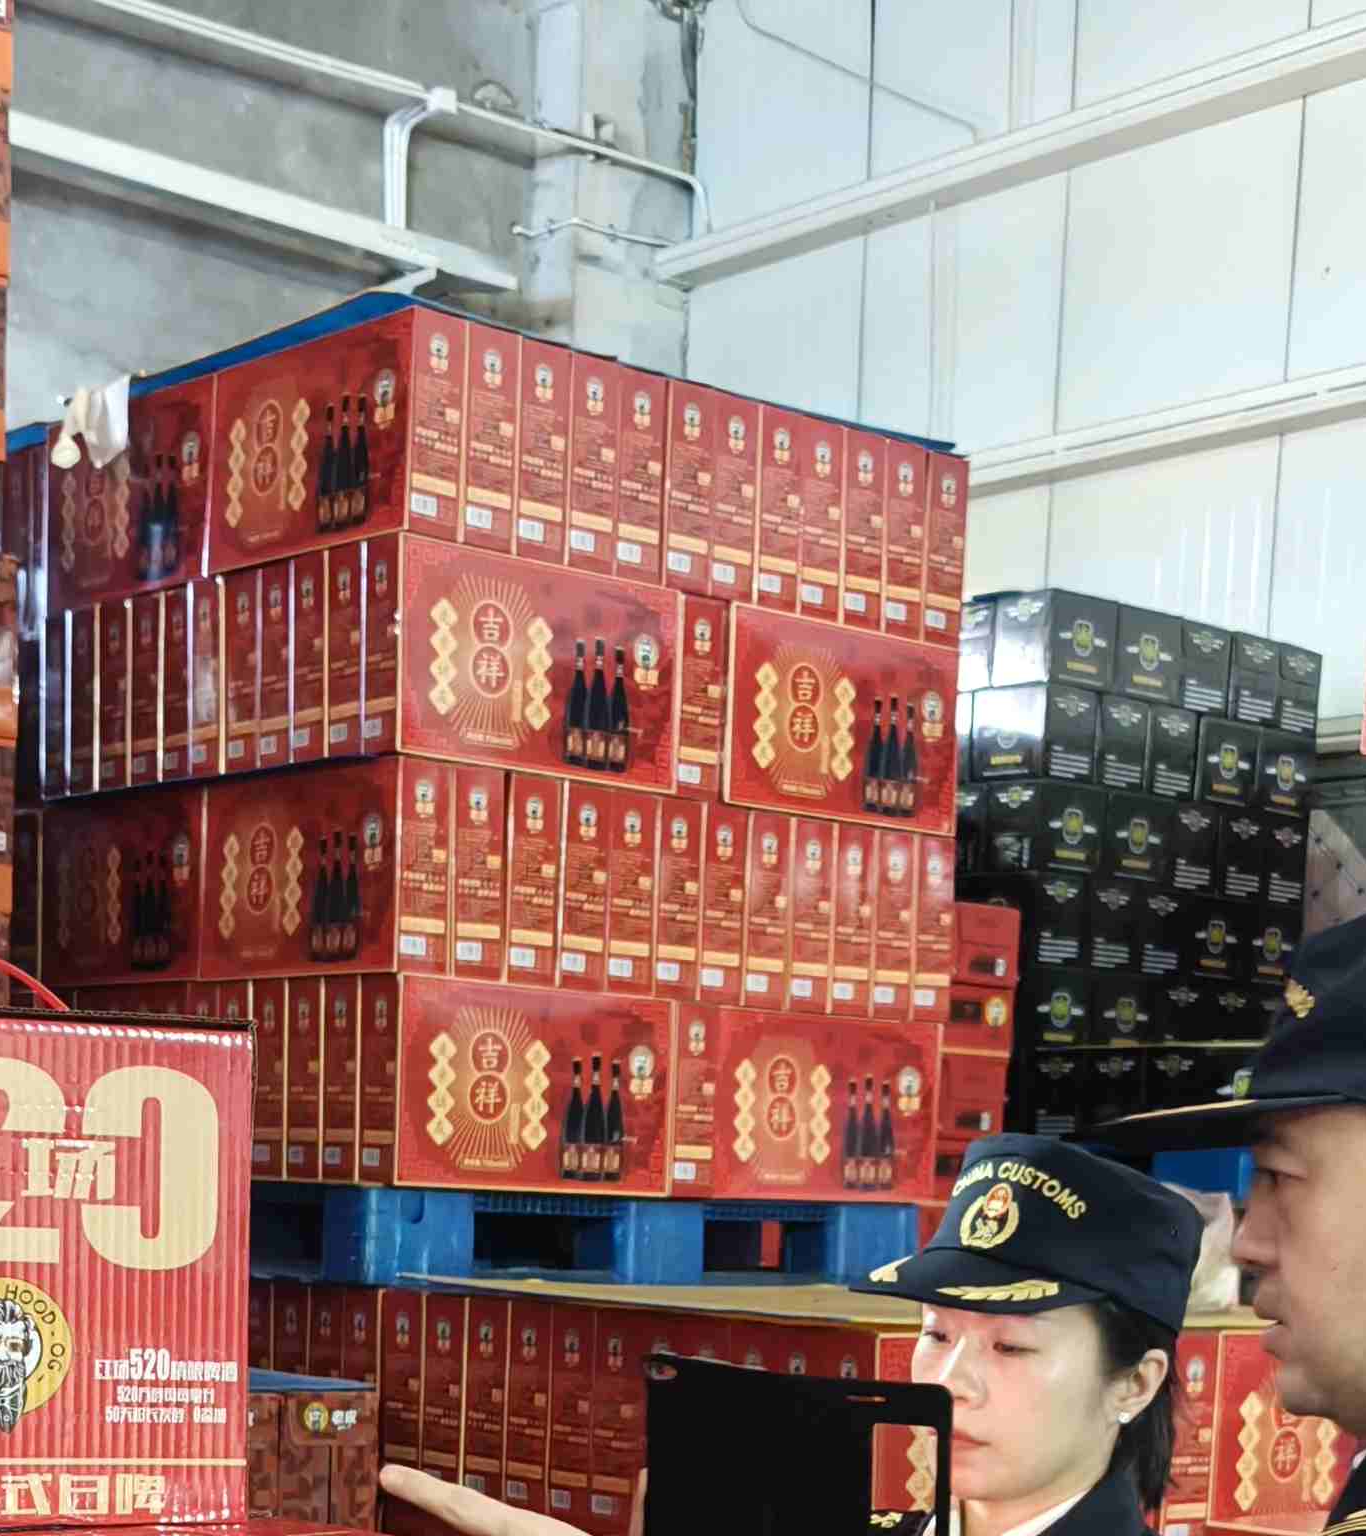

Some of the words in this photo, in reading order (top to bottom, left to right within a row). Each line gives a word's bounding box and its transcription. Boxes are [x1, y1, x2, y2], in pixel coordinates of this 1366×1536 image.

[998, 1161, 1086, 1219] CUSTOMS
[4, 1284, 56, 1326] HOOD
[45, 1342, 66, 1370] OG
